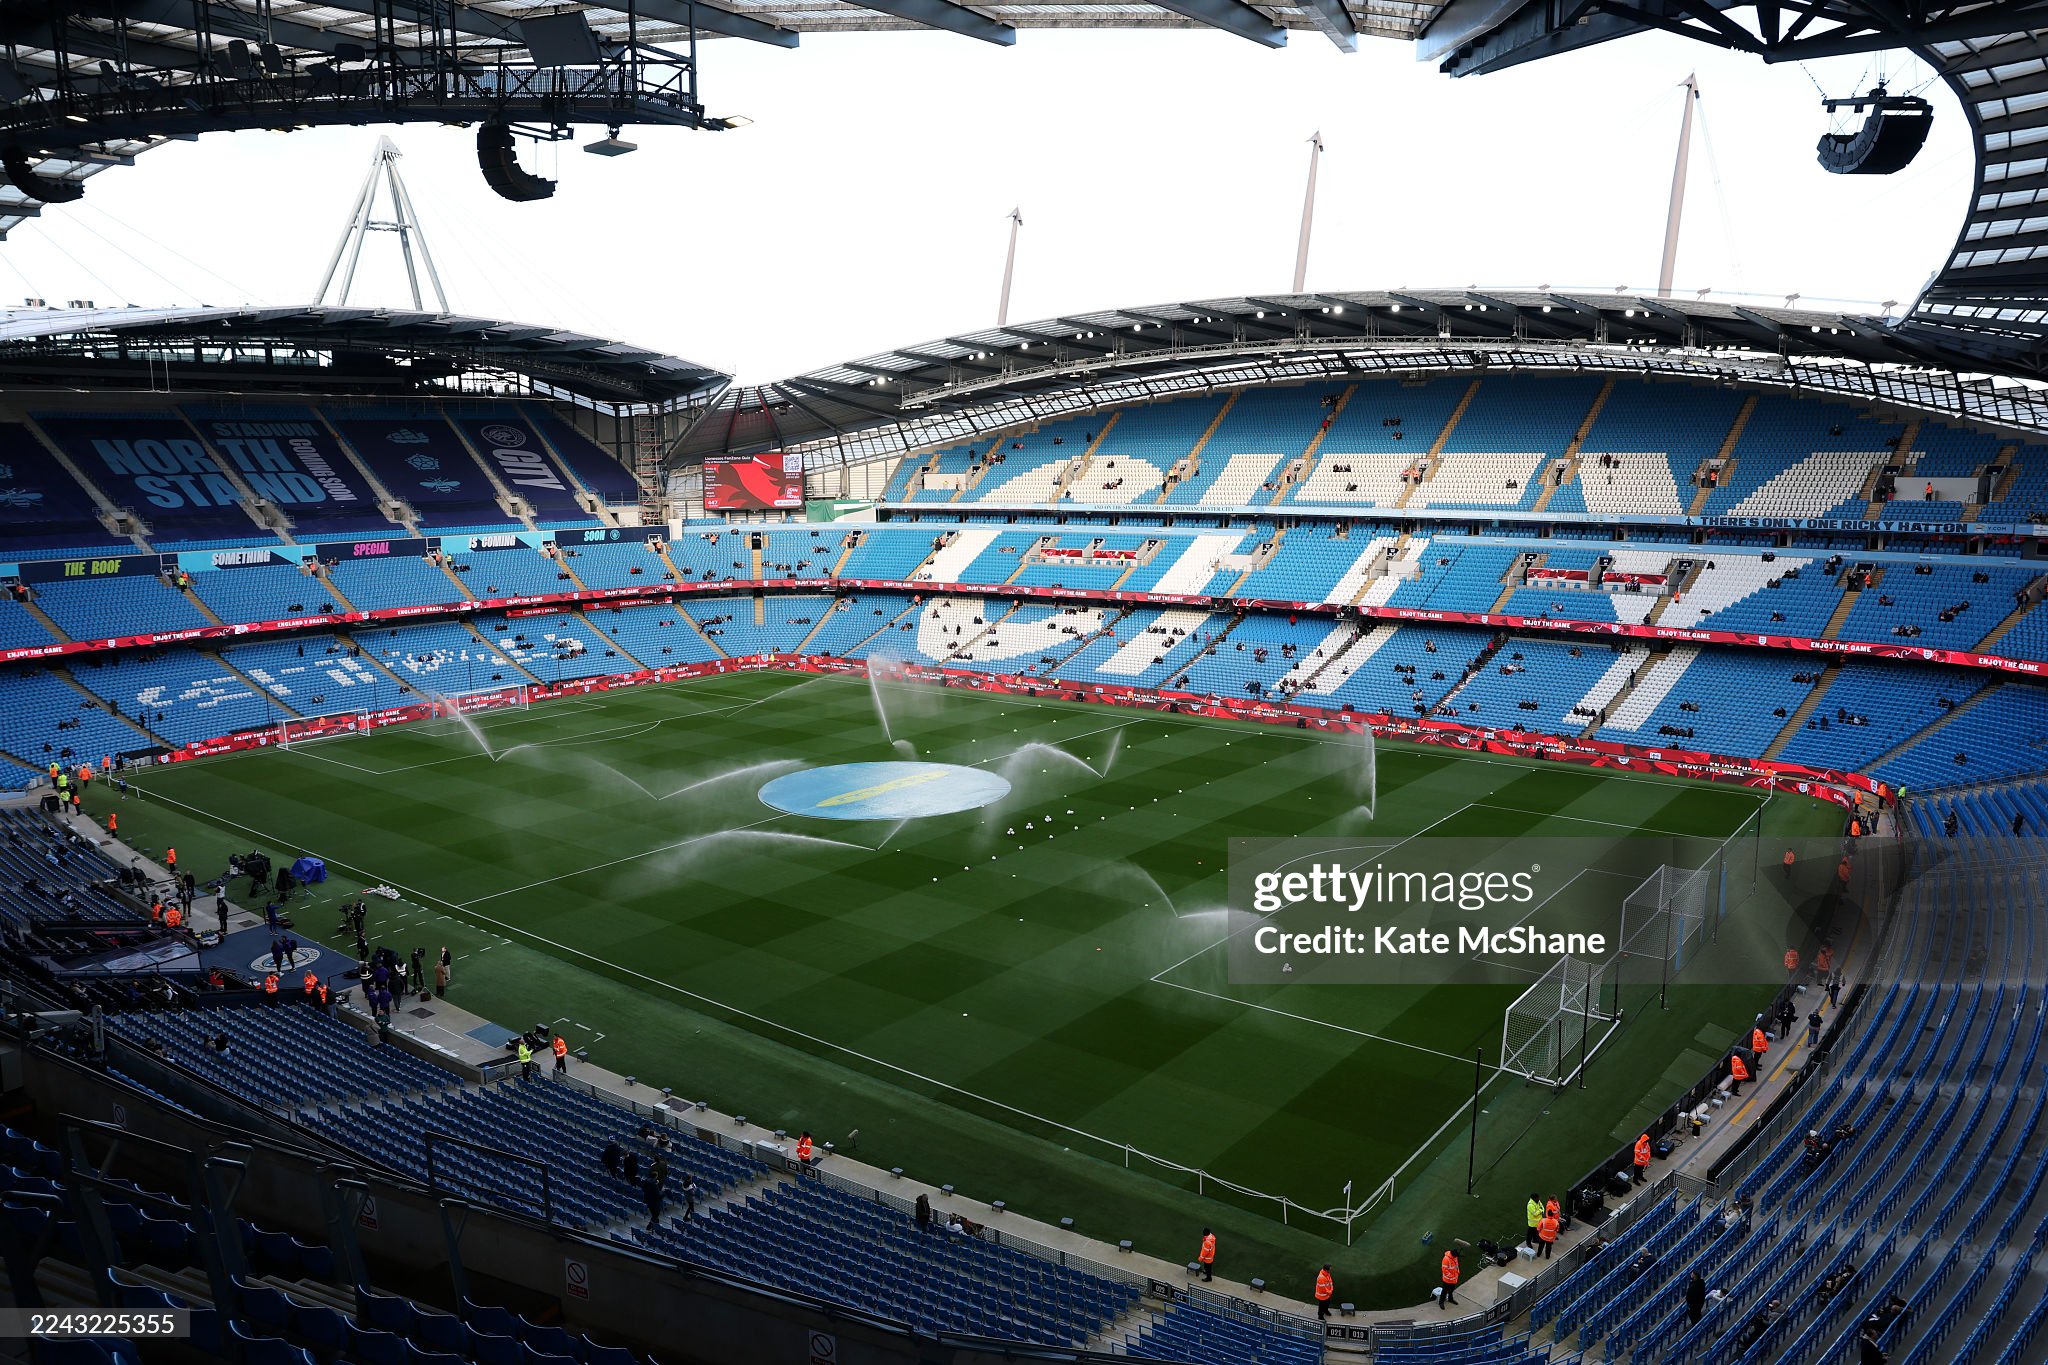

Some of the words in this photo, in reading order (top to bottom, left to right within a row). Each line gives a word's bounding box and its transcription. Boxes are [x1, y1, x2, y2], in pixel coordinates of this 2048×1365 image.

[211, 422, 319, 436] STADIUM
[288, 438, 336, 476] COMING
[318, 476, 358, 500] SOON
[492, 448, 566, 490] CITY
[1700, 516, 1760, 528] THERE'S
[1762, 518, 1801, 528] ONLY
[1807, 519, 1839, 530] ONE
[1841, 520, 1894, 531] RICKY
[1898, 522, 1968, 533] HATTON
[469, 538, 478, 549] IS
[482, 535, 516, 548] COMING
[583, 530, 606, 542] SOON
[354, 542, 390, 556] SPECIAL
[212, 550, 270, 566] SOMETHING
[64, 562, 86, 576] THE
[92, 560, 121, 574] ROOF
[1979, 658, 2002, 666] ENJOY
[2018, 663, 2038, 671] GAME
